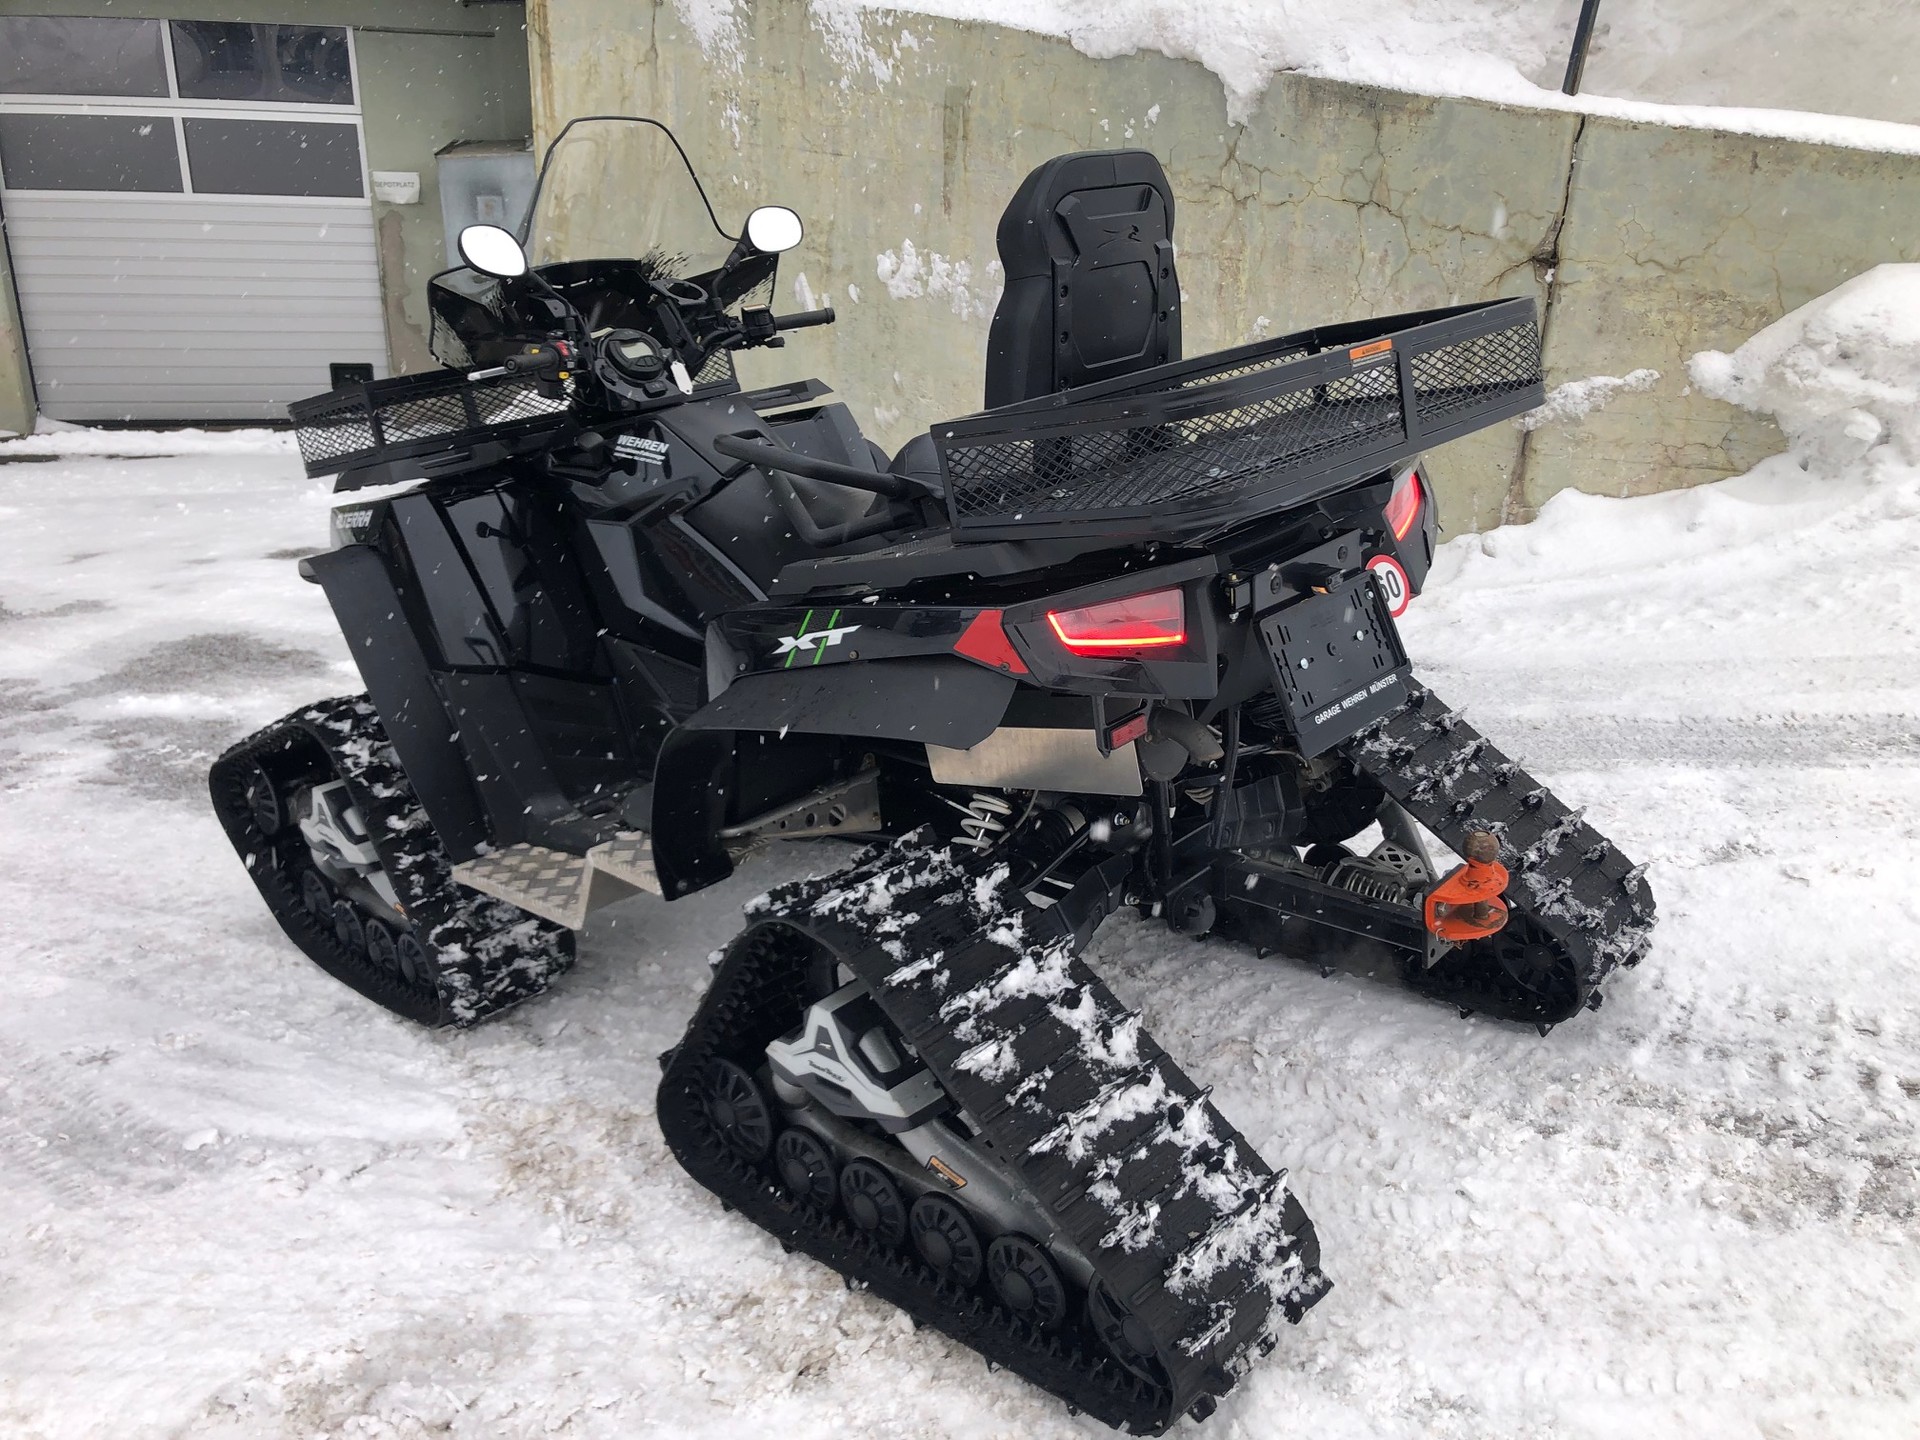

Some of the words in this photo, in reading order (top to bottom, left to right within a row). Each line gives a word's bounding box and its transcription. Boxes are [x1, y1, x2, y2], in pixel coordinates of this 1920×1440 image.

[617, 434, 670, 453] WEHREN
[771, 624, 862, 655] XT
[1314, 703, 1342, 725] GARAGE
[1340, 688, 1368, 710] WEHREN
[1368, 673, 1398, 694] MÜNSTER
